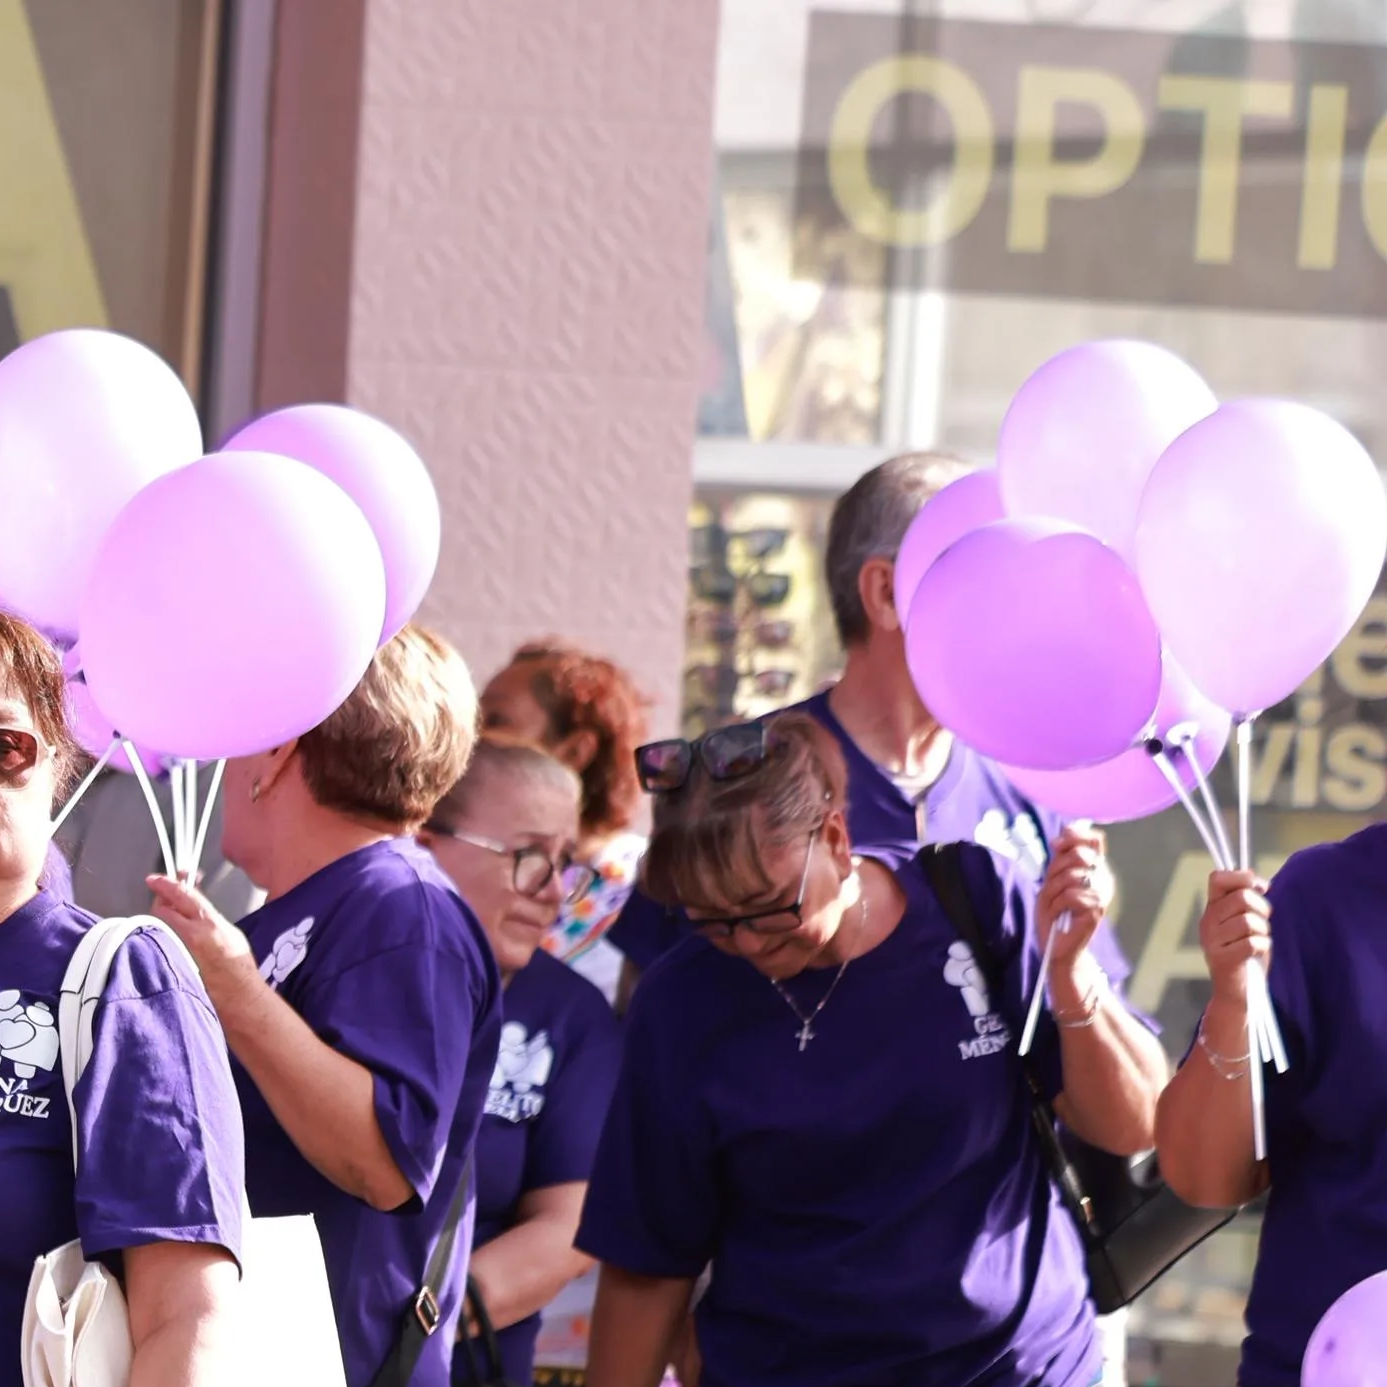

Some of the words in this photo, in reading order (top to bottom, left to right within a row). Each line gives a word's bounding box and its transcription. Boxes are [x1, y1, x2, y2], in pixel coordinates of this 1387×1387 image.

[828, 53, 1387, 272] OPTI
[973, 1014, 1004, 1036] GE
[957, 1030, 1012, 1061] MÉN
